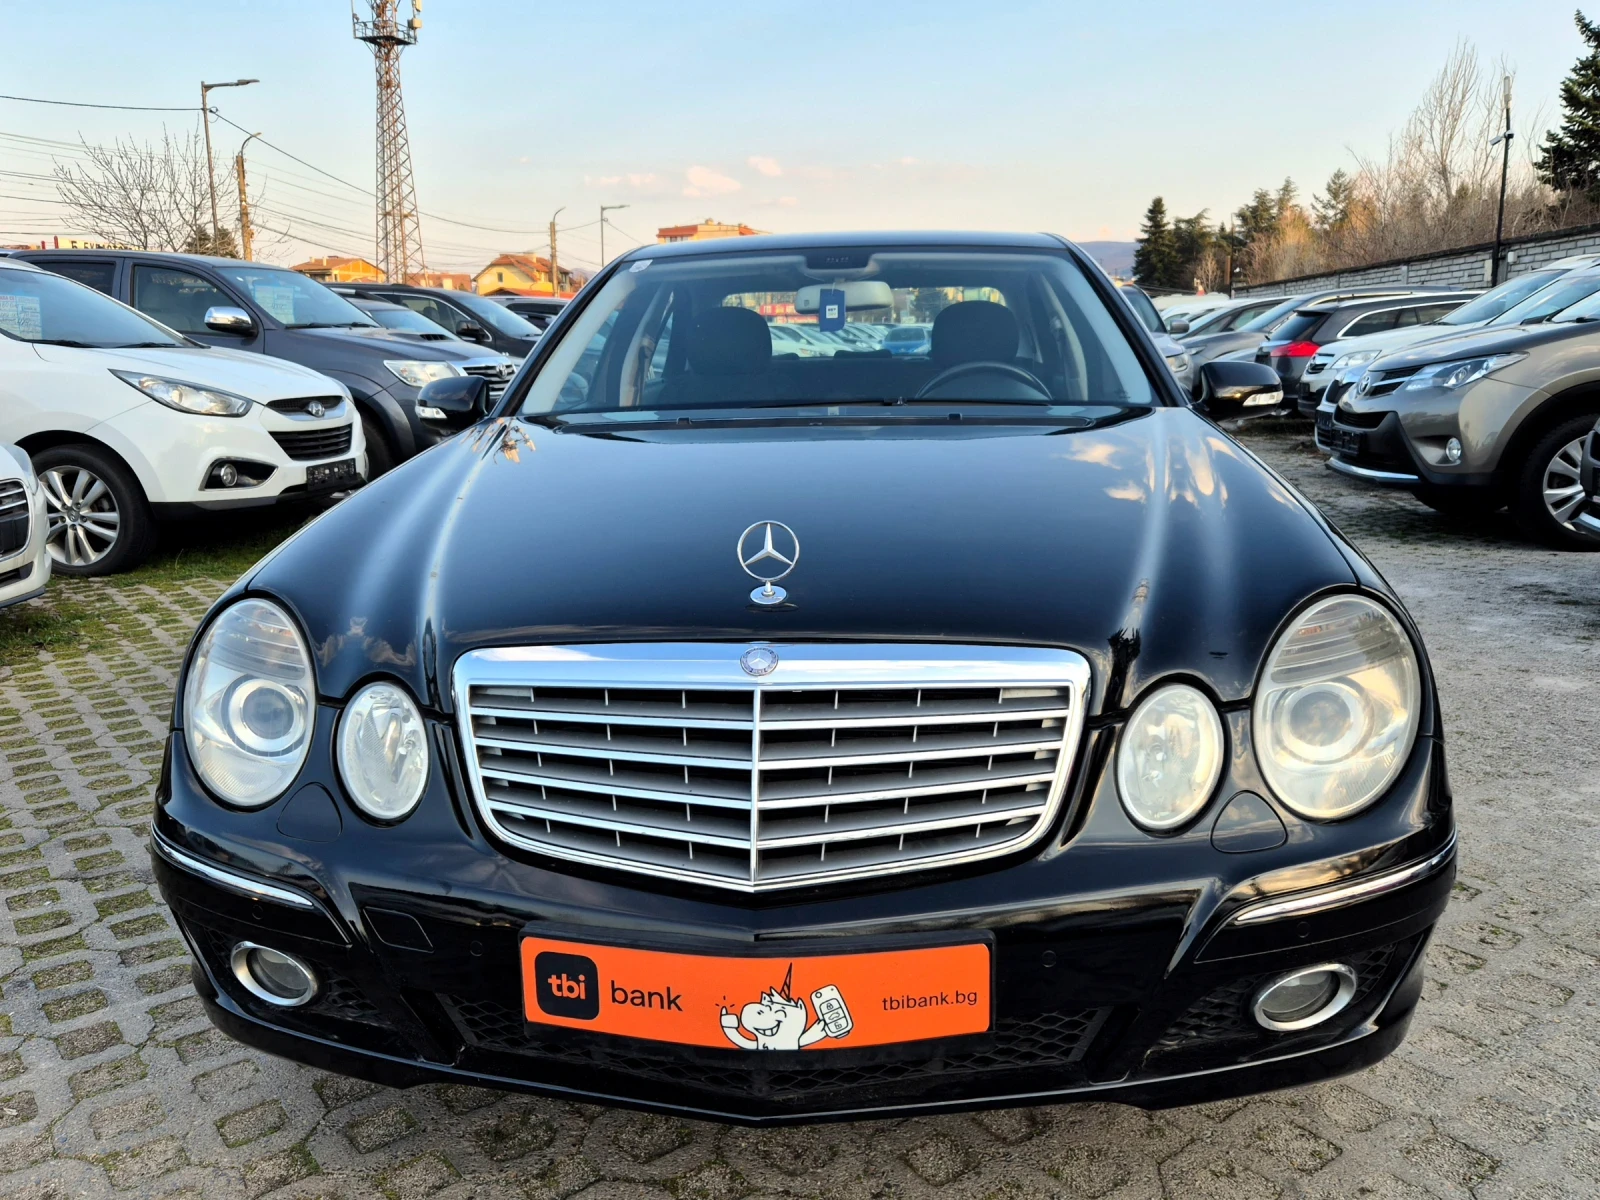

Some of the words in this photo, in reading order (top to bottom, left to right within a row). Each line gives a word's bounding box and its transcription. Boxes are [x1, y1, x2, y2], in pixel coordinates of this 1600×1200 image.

[548, 973, 586, 1000] tbi
[611, 980, 683, 1011] bank
[882, 990, 978, 1011] tbibank.bg
